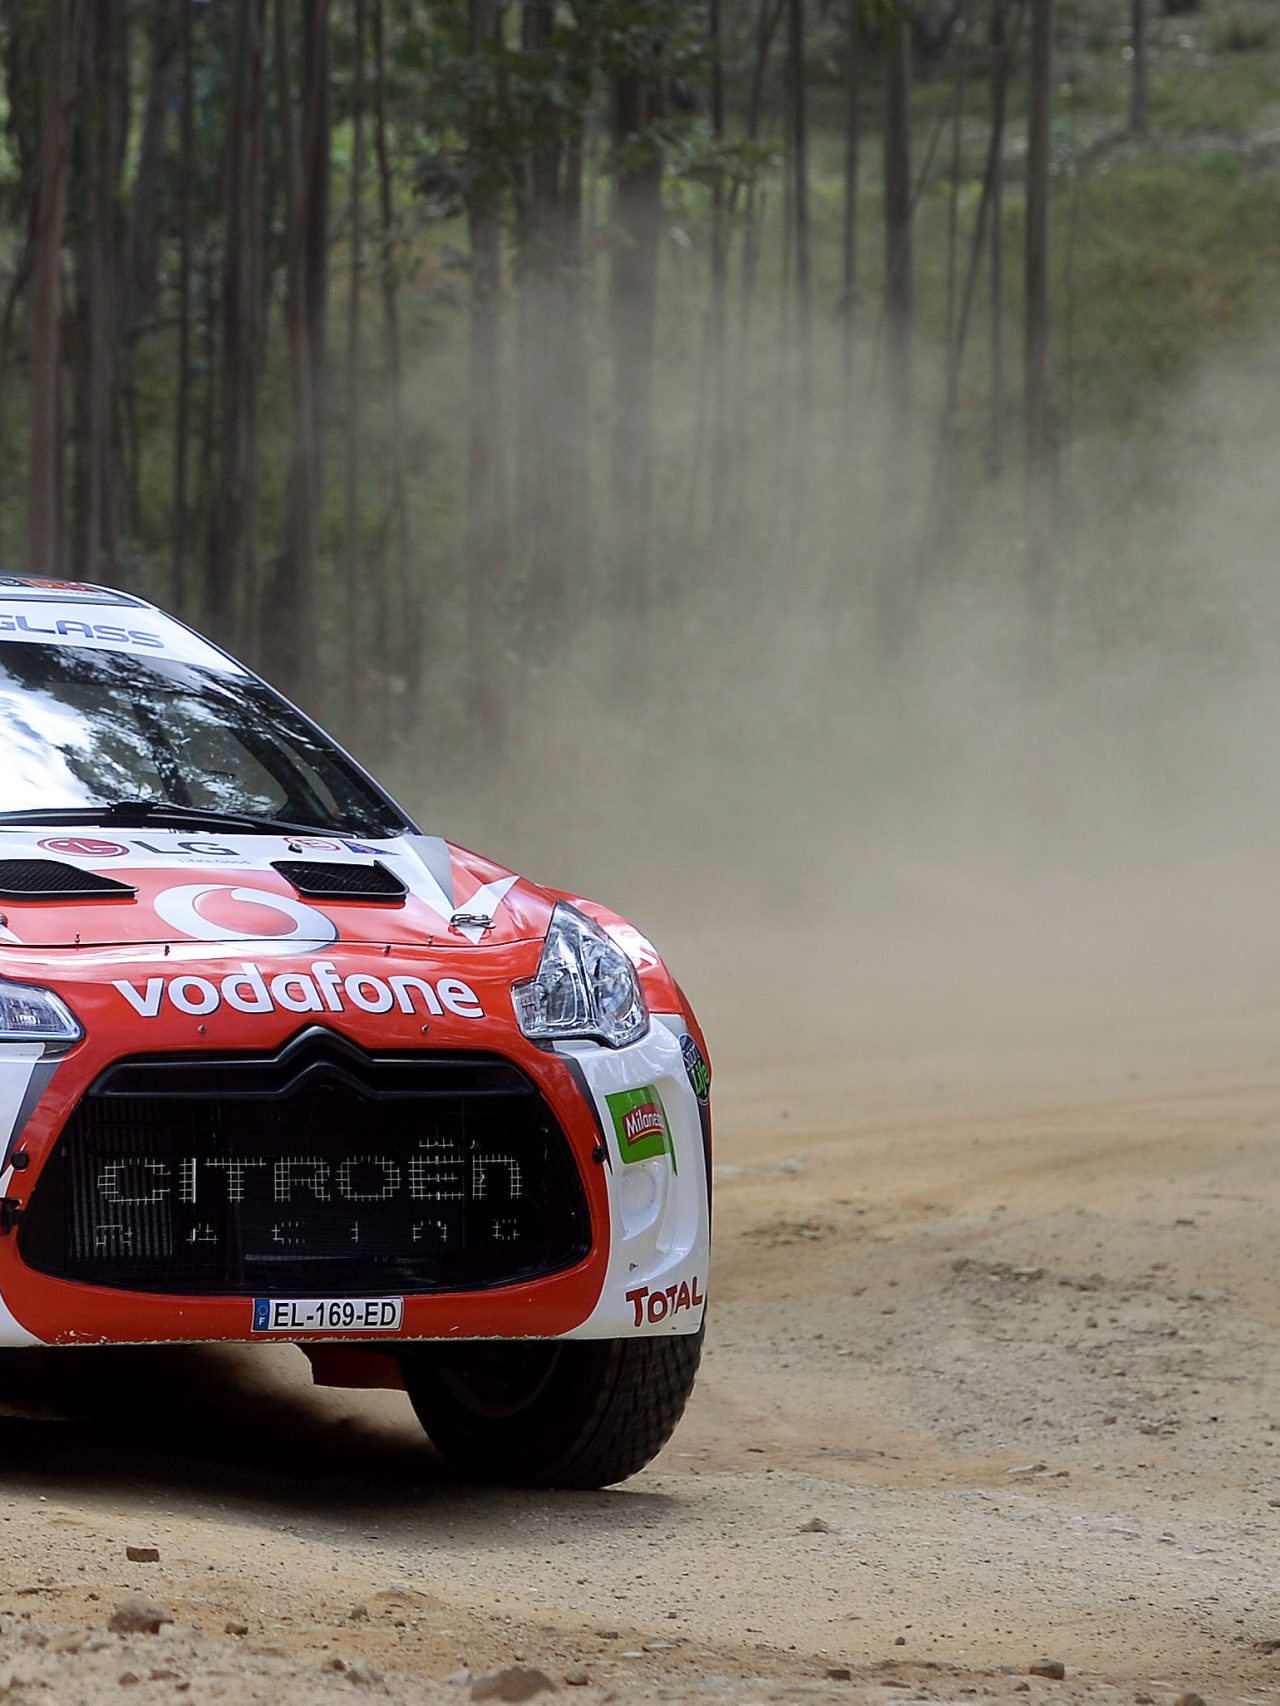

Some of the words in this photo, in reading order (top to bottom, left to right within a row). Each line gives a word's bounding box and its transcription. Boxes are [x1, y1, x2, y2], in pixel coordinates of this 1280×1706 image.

[130, 840, 241, 856] LG
[111, 961, 484, 1018] vodafone
[258, 1317, 265, 1326] F
[273, 1302, 396, 1327] EL-169-ED
[625, 1276, 703, 1328] TOTAL
